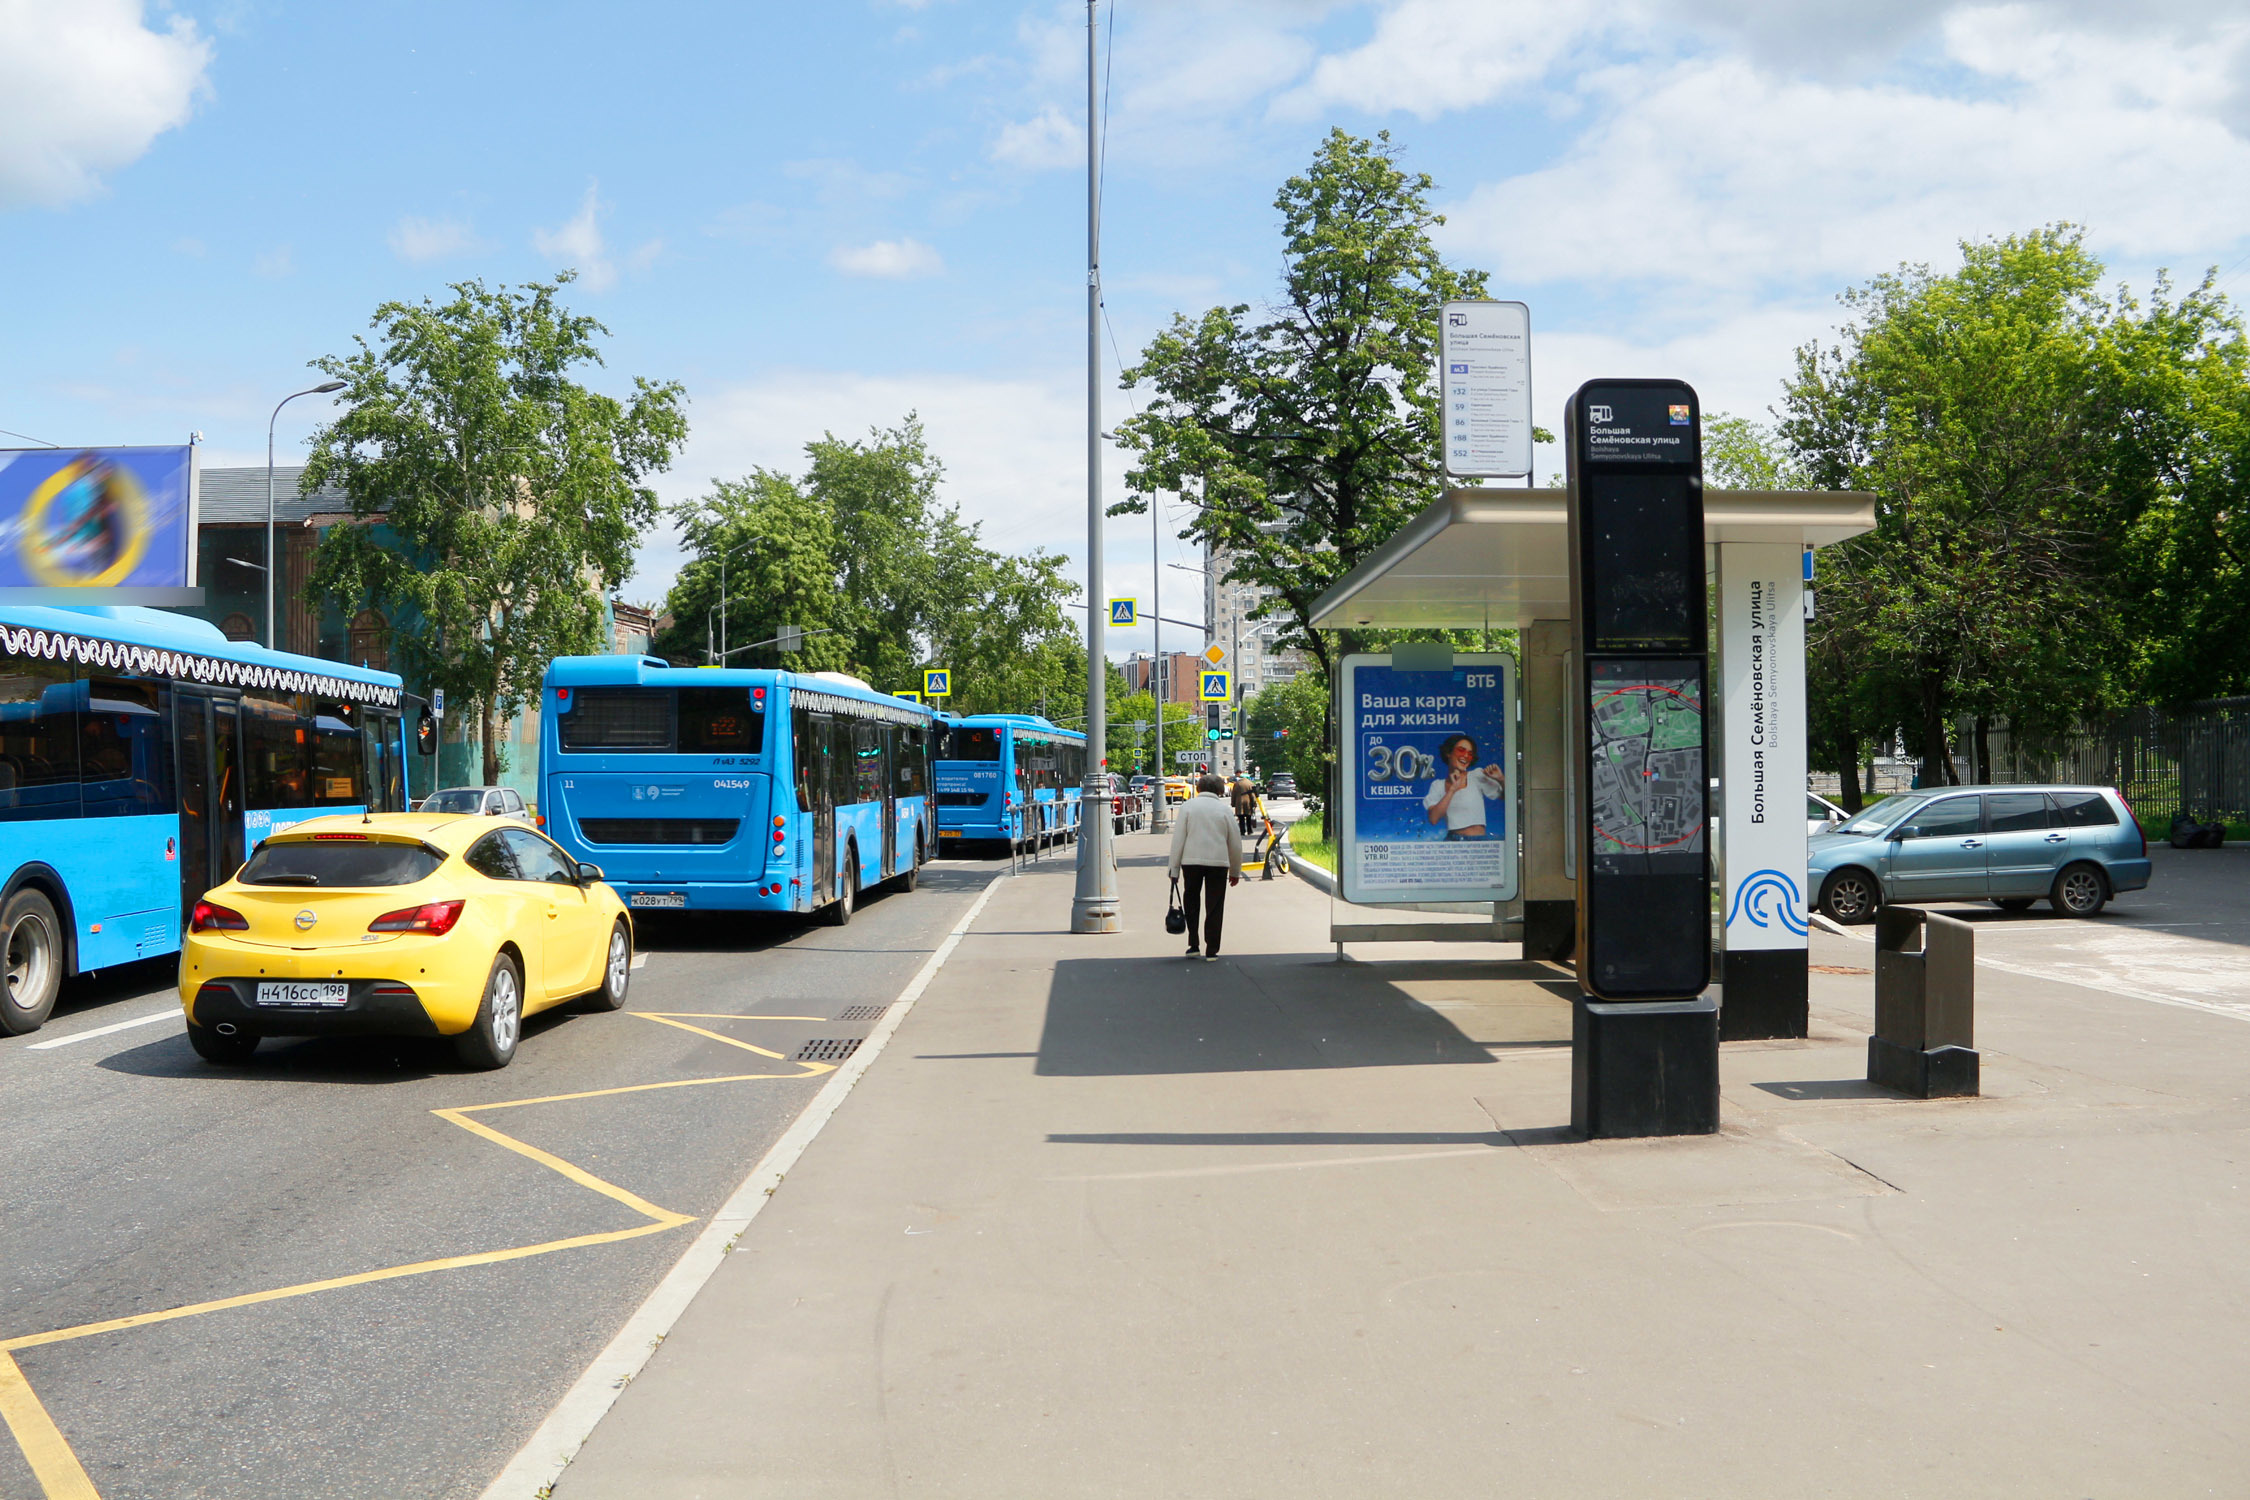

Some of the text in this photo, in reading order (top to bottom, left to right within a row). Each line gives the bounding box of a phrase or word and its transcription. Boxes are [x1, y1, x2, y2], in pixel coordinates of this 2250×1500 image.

[1455, 403, 1465, 411] 59
[1590, 426, 1631, 435] Большая
[1590, 435, 1680, 446] Семёновская улица
[1453, 449, 1467, 457] 552
[1766, 581, 1780, 748] Bolshaya Semyonovskaya Ulitsa
[1466, 674, 1496, 688] ВТБ
[1362, 693, 1466, 711] Ваша карта
[1750, 581, 1764, 824] Большая Семёновская улица
[1361, 713, 1459, 728] для жизни
[1180, 753, 1206, 761] СТОП
[1368, 745, 1436, 781] 30%
[564, 780, 574, 788] 11
[713, 780, 750, 788] 041549
[1370, 785, 1413, 795] КЕШБЭК
[261, 985, 344, 1000] Н416СС 198
